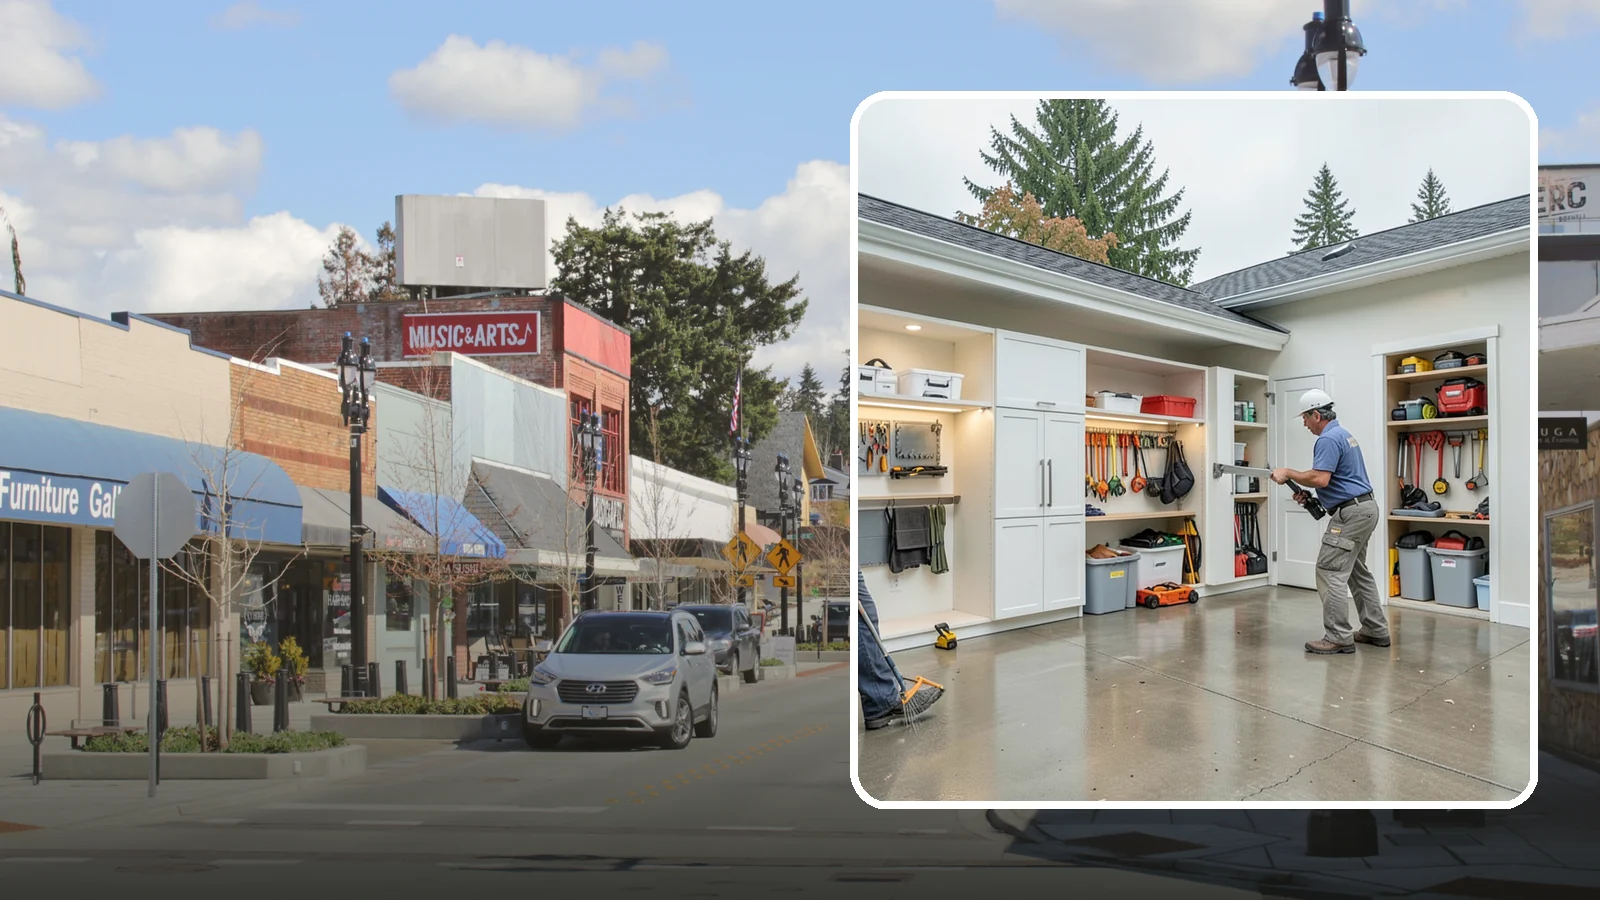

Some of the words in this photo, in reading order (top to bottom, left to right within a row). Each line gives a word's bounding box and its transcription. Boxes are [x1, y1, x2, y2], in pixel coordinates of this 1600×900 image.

[1540, 428, 1577, 436] UGA
[0, 471, 79, 516] Furniture
[89, 482, 122, 519] Gal
